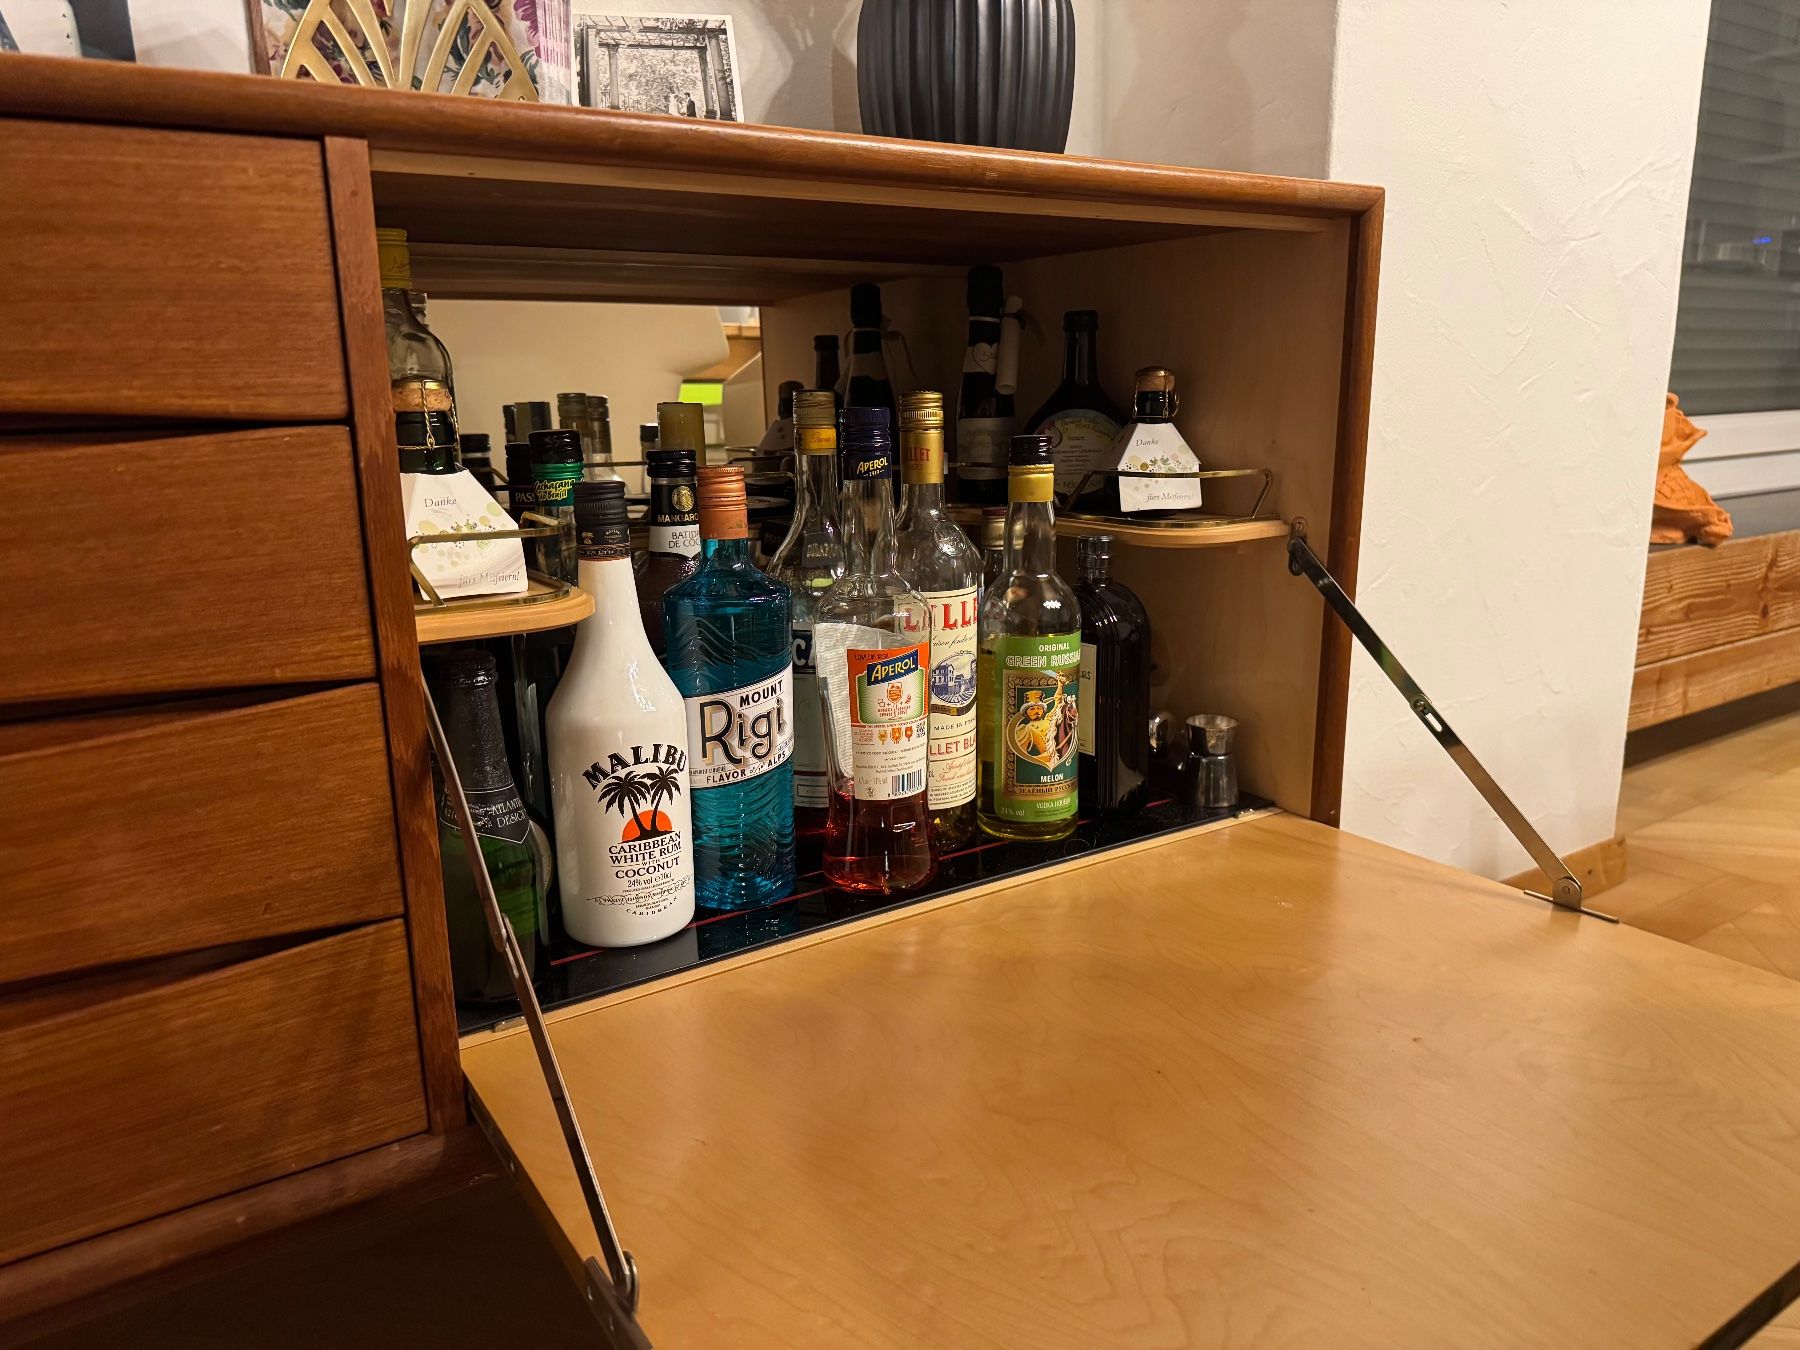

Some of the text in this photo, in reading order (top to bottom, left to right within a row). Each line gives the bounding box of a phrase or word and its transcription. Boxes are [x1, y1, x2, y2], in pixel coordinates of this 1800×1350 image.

[1136, 438, 1160, 447] Danke
[857, 456, 889, 475] APEROL
[424, 496, 457, 508] Danke
[668, 540, 680, 549] DE
[1039, 642, 1070, 652] ORIGINAL
[1006, 655, 1046, 667] GREEN
[871, 657, 916, 681] APEROL
[740, 680, 783, 708] MOUNT
[700, 698, 783, 764] Rigi
[934, 724, 954, 732] MADE
[582, 743, 687, 791] MALIBU
[706, 769, 747, 784] FLAVOR
[767, 750, 786, 768] ALPS
[1040, 773, 1064, 783] MELON
[608, 831, 681, 854] CARIBBEAN
[609, 841, 681, 865] WHITE RUM
[615, 856, 680, 879] COCONUT
[641, 859, 660, 867] WITH
[627, 878, 642, 888] 24%
[643, 877, 653, 885] vol
